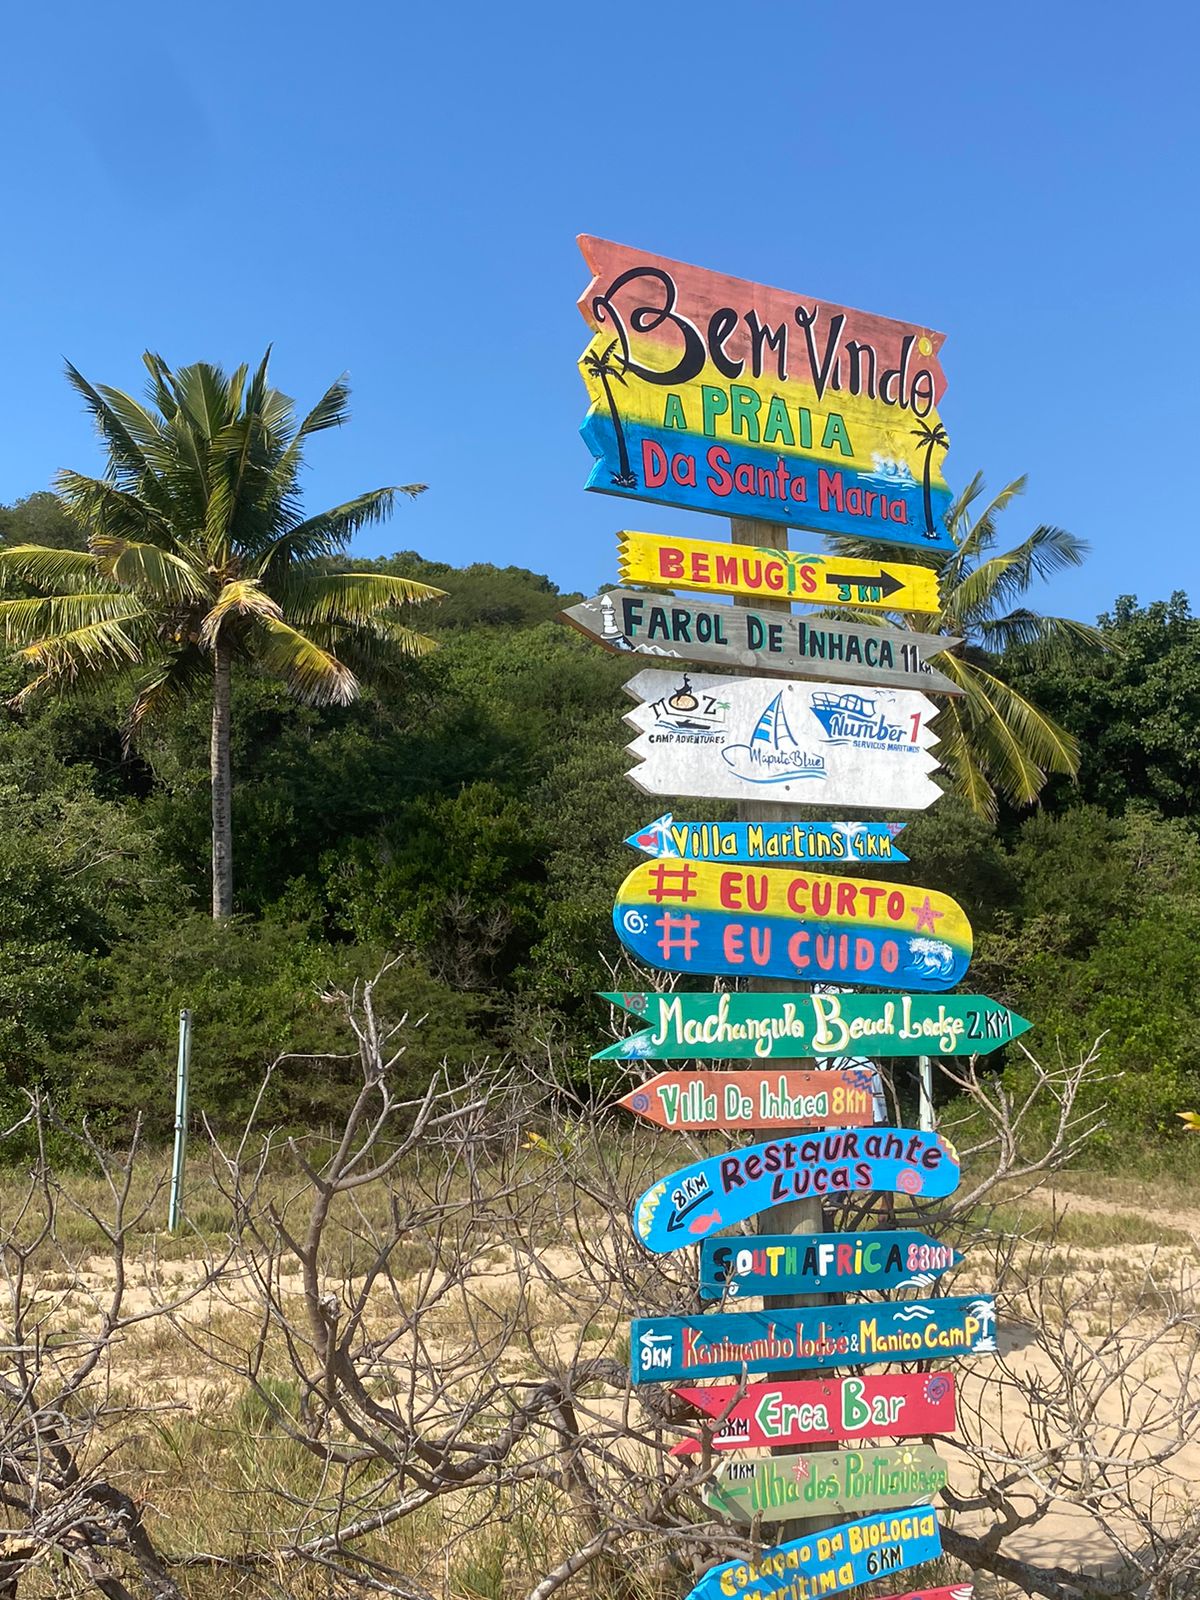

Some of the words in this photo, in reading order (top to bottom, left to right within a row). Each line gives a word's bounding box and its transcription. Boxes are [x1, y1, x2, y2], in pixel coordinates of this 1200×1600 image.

[592, 267, 787, 385] Bem
[795, 304, 935, 417] Vindo
[663, 393, 687, 430] A
[701, 384, 855, 457] PRAIA
[641, 439, 695, 489] Da
[705, 445, 807, 502] Santa
[818, 468, 908, 524] Maria
[621, 598, 728, 645] FAROL
[747, 614, 784, 653] DE
[798, 622, 896, 669] INHACA
[648, 734, 675, 744] CAMP
[675, 735, 726, 745] ADVENTURES
[830, 713, 908, 742] Number
[910, 712, 922, 743] 1
[670, 823, 737, 858] Villa
[748, 824, 845, 858] Martins
[719, 872, 769, 911] EU
[787, 878, 905, 920] CURTO
[723, 924, 772, 966] EU
[787, 931, 899, 973] CUIDO
[651, 992, 805, 1058] Machangula
[898, 996, 965, 1053] Lodge
[657, 1080, 716, 1125] Villa
[724, 1083, 753, 1121] De
[760, 1075, 829, 1121] Inhaca
[712, 1244, 797, 1283] SOUTH
[859, 1317, 921, 1355] Manico
[841, 1377, 906, 1431] Bar
[804, 1464, 842, 1501] dos
[817, 1533, 844, 1562] Da
